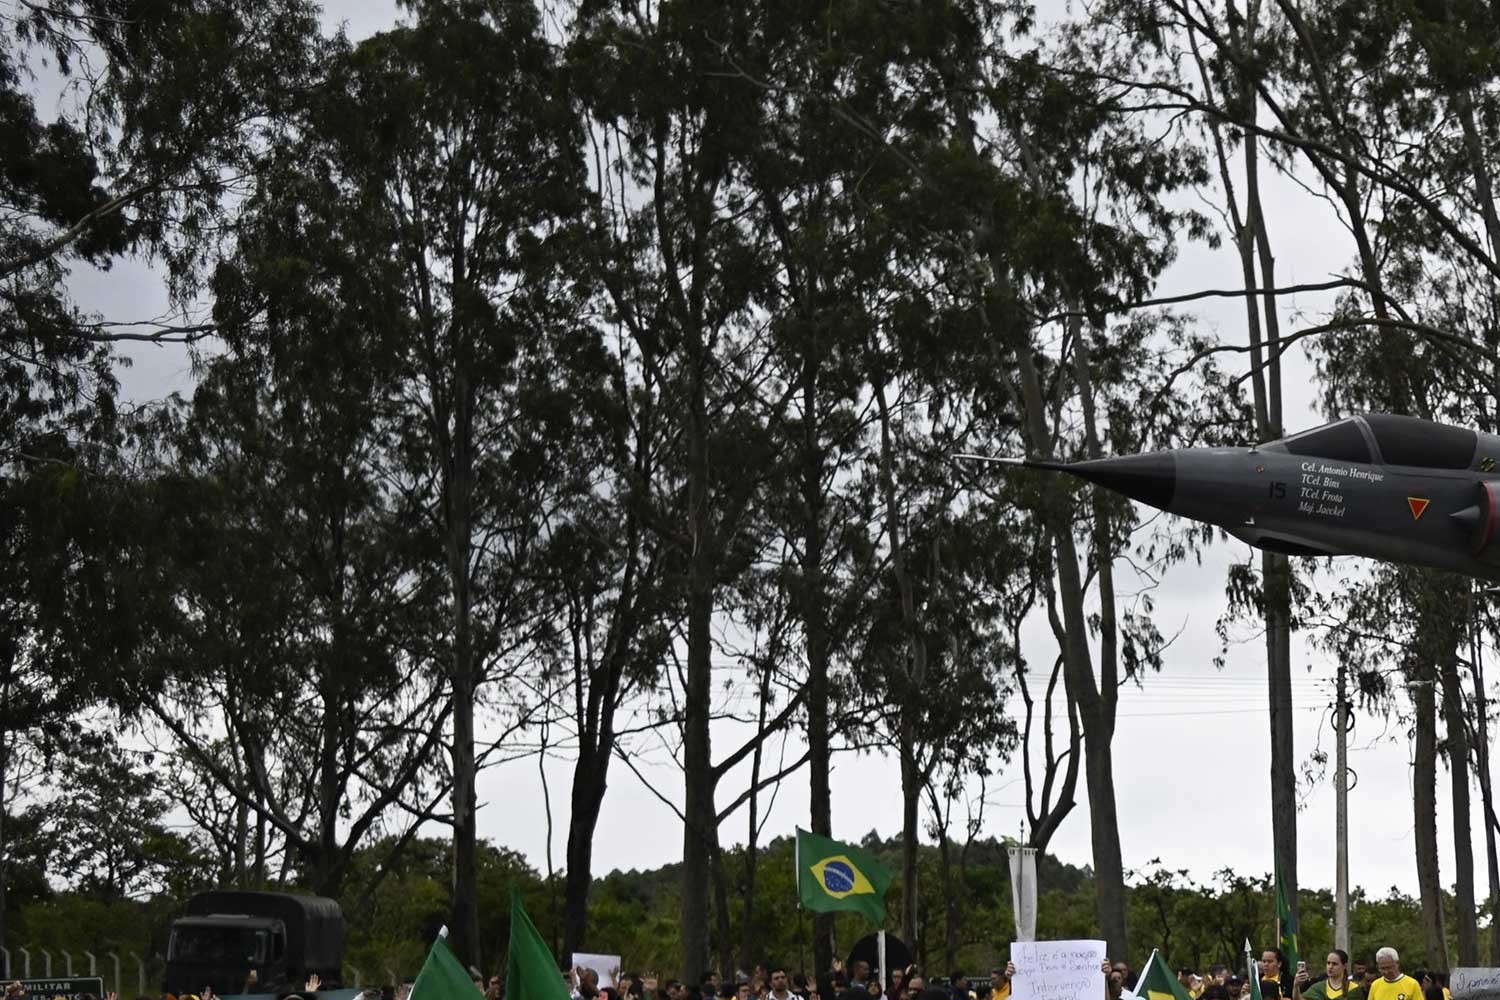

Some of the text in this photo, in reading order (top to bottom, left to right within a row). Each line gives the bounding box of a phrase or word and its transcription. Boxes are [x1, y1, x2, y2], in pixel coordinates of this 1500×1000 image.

[1301, 461, 1384, 483] Cel. Antonio Henrique
[1301, 473, 1340, 488] TCel. Bins
[1269, 481, 1287, 499] 15
[1300, 487, 1343, 503] TCel. Frota
[24, 982, 71, 992] MILITAR
